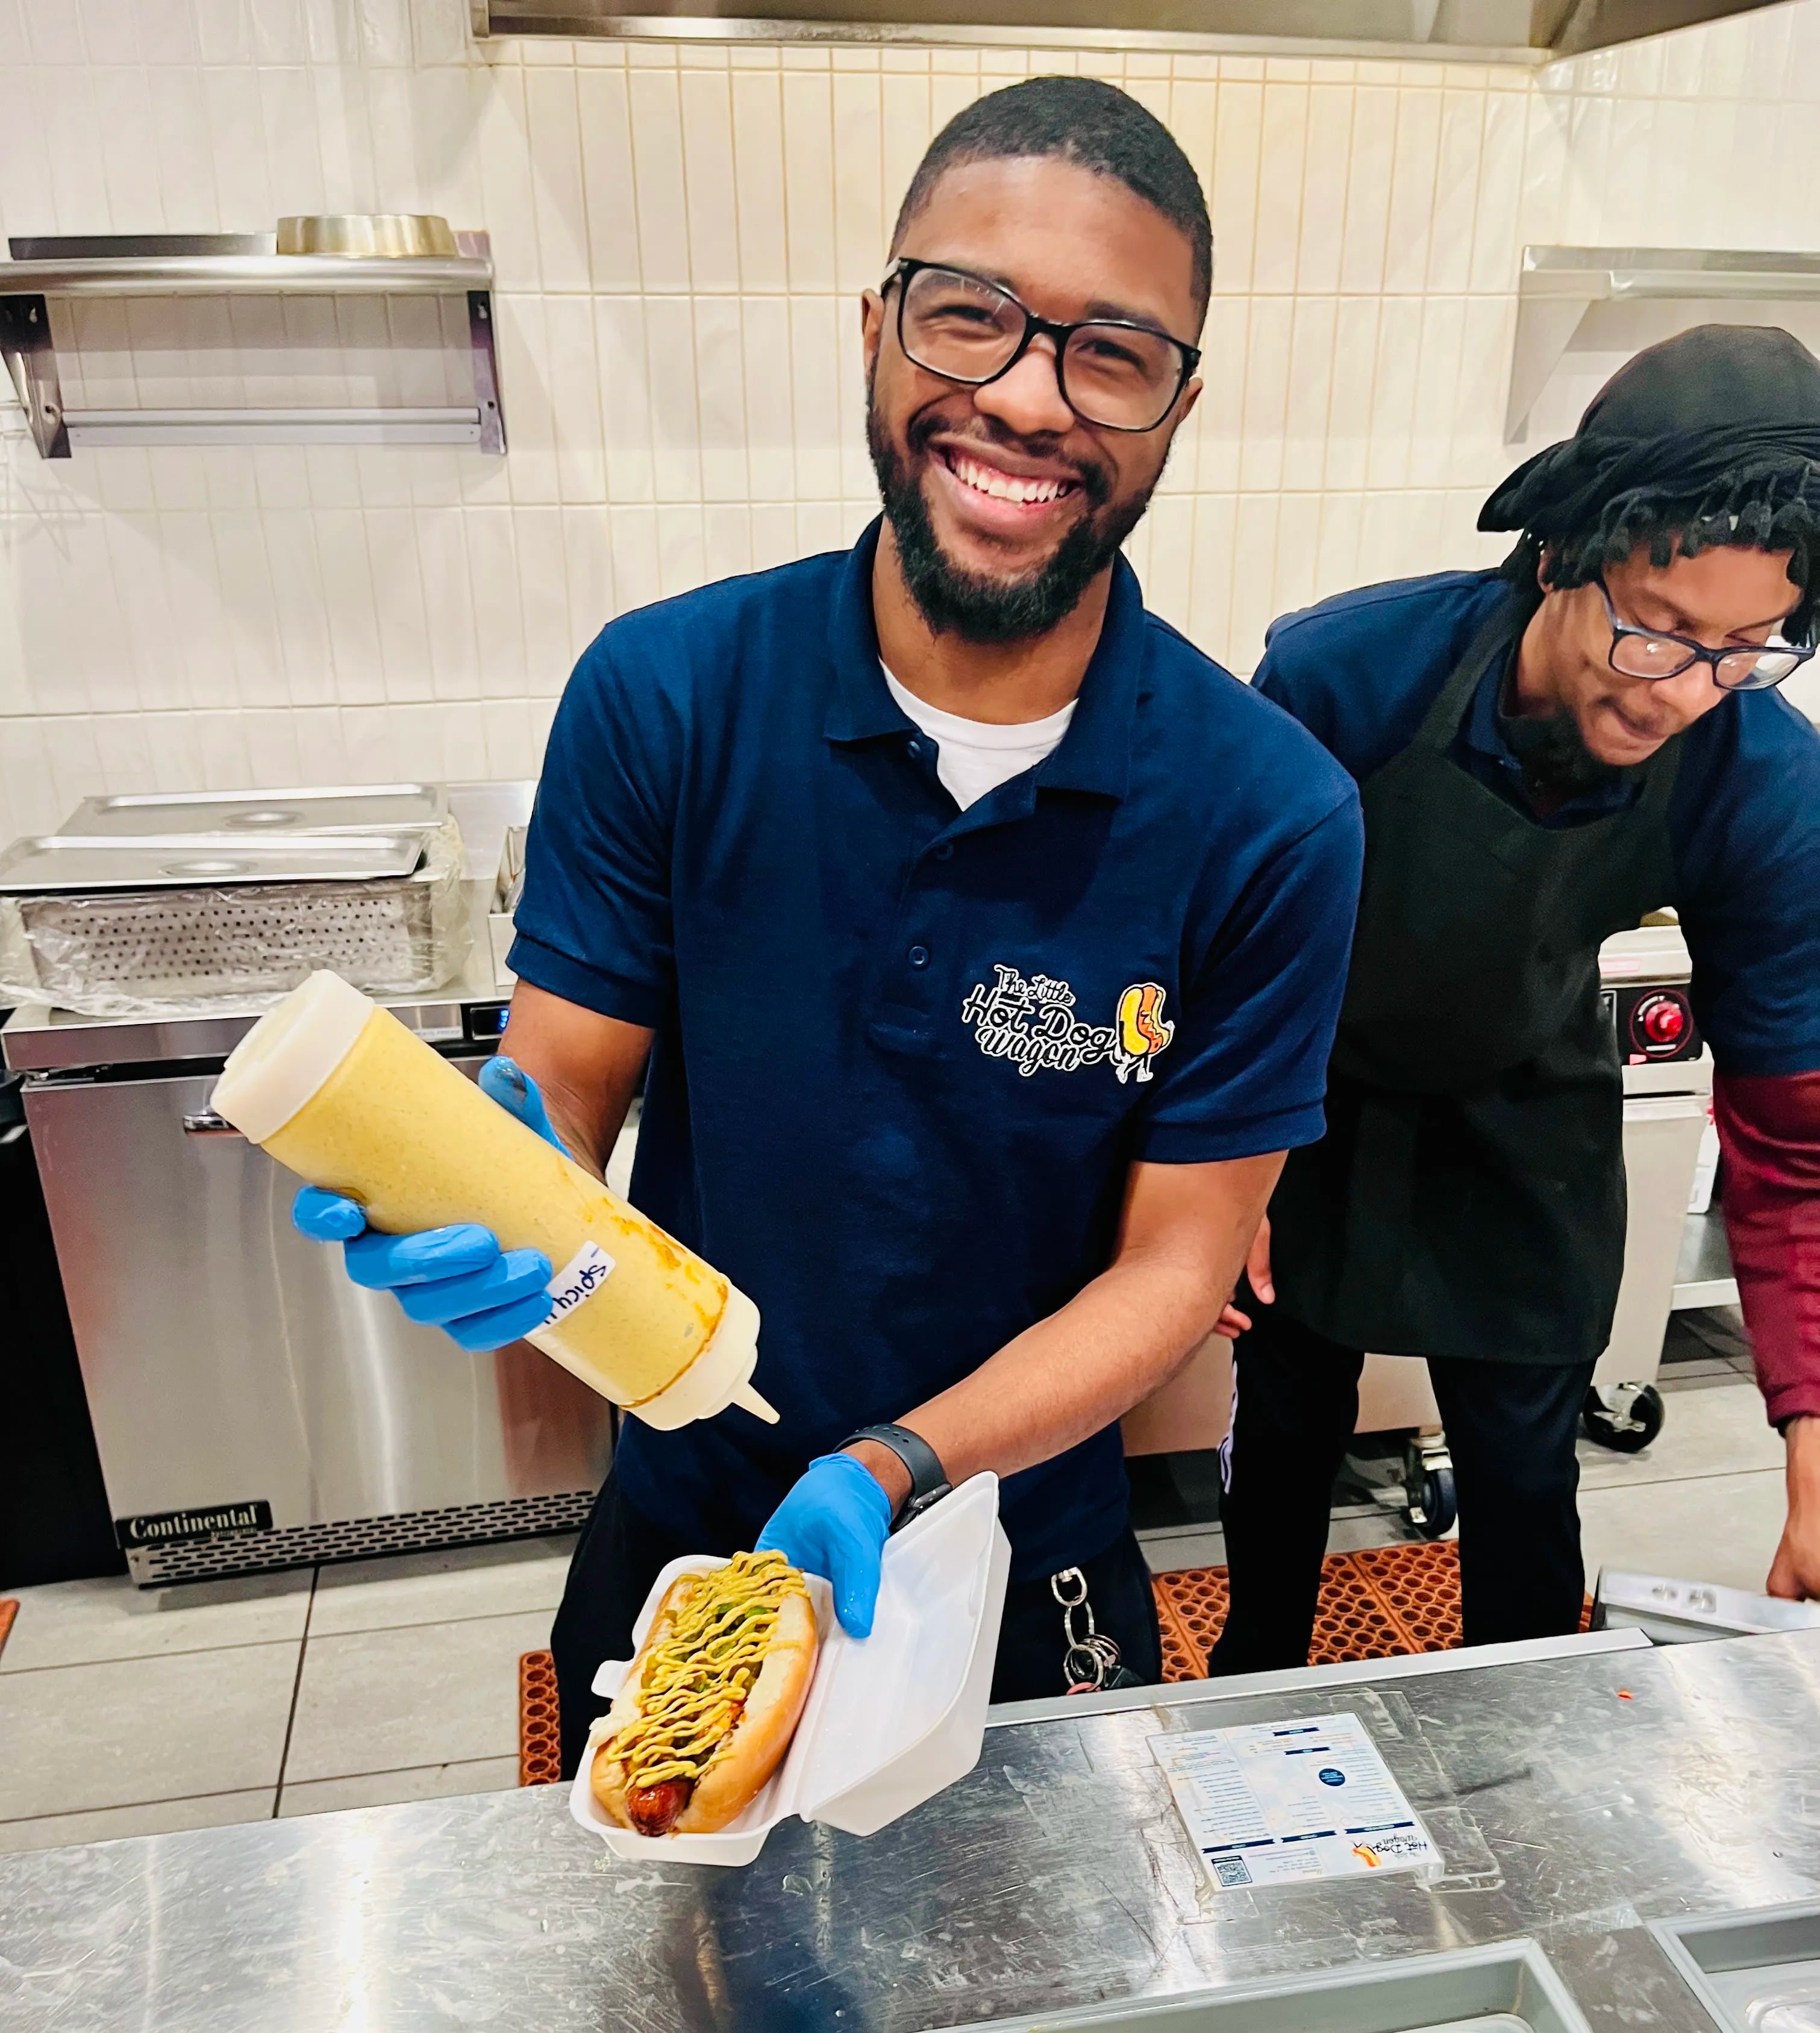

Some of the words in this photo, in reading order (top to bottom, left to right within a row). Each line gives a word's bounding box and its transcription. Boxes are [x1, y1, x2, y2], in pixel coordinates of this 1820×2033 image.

[962, 984, 1035, 1034] Hot
[1031, 1004, 1117, 1064] Dog
[130, 1505, 257, 1539] Continental
[1372, 1842, 1403, 1853] Dog
[1404, 1841, 1427, 1851] Hot
